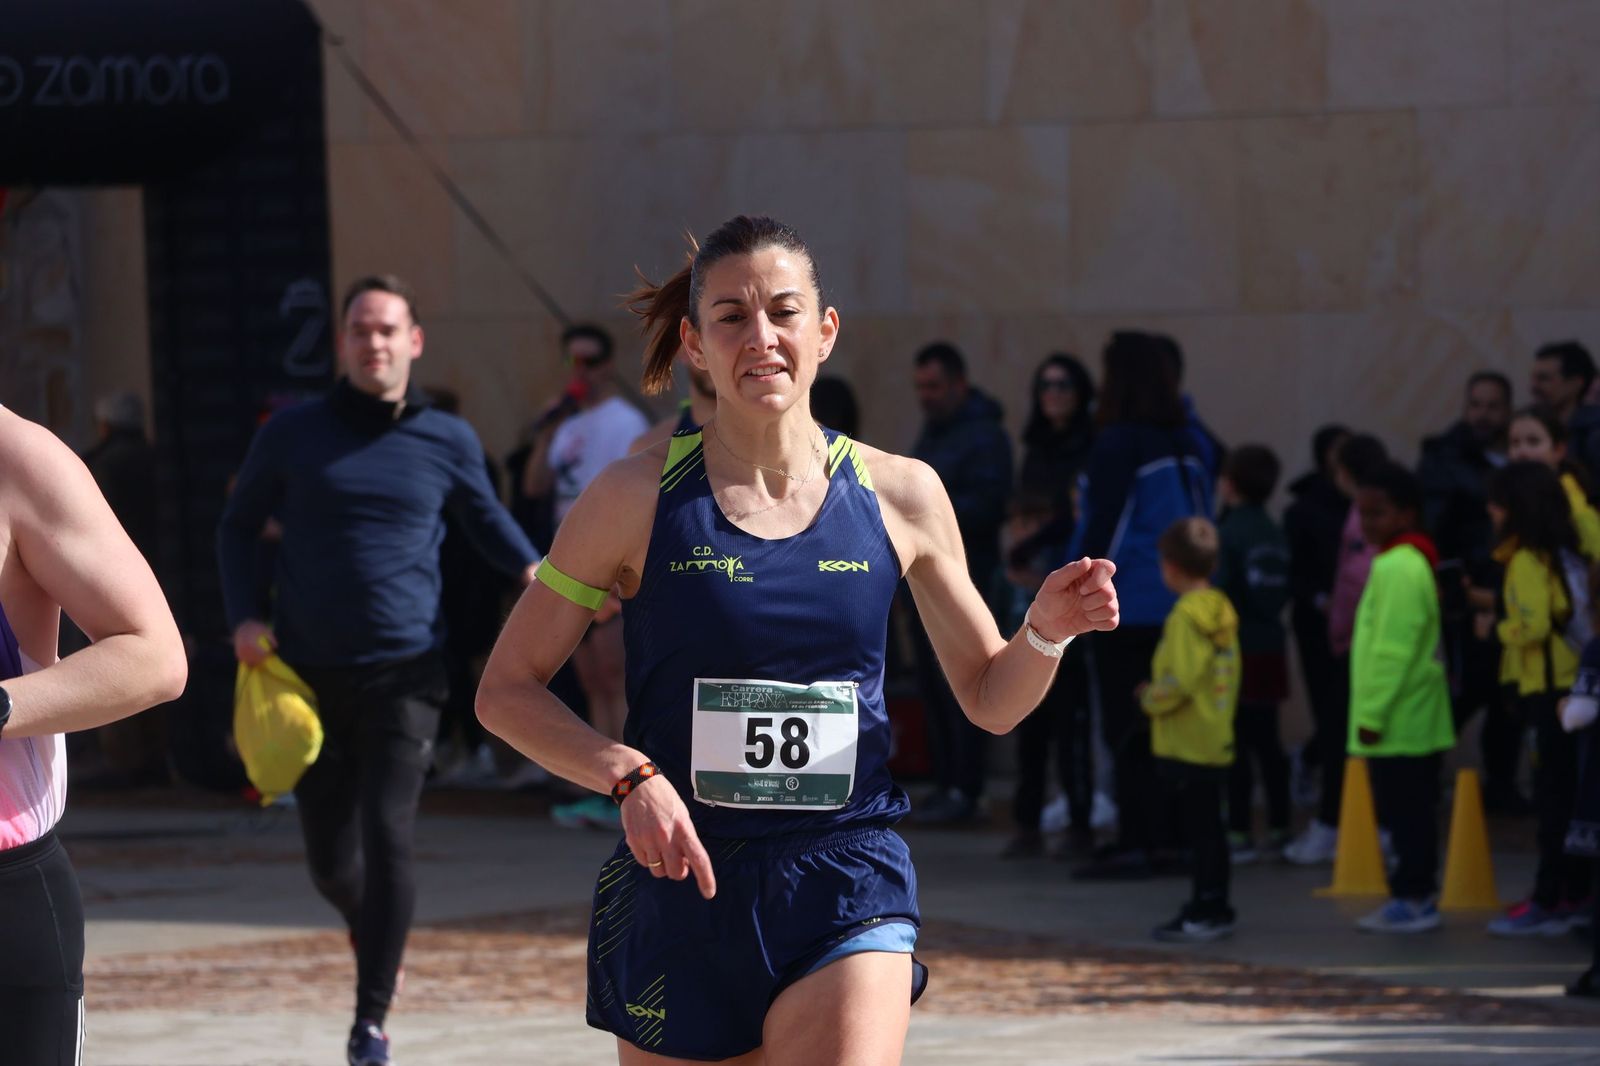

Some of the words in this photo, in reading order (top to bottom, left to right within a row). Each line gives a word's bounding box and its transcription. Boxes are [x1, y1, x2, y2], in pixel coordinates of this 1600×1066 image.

[692, 546, 714, 556] C.D.
[731, 685, 773, 693] Carrera
[744, 717, 810, 769] 58
